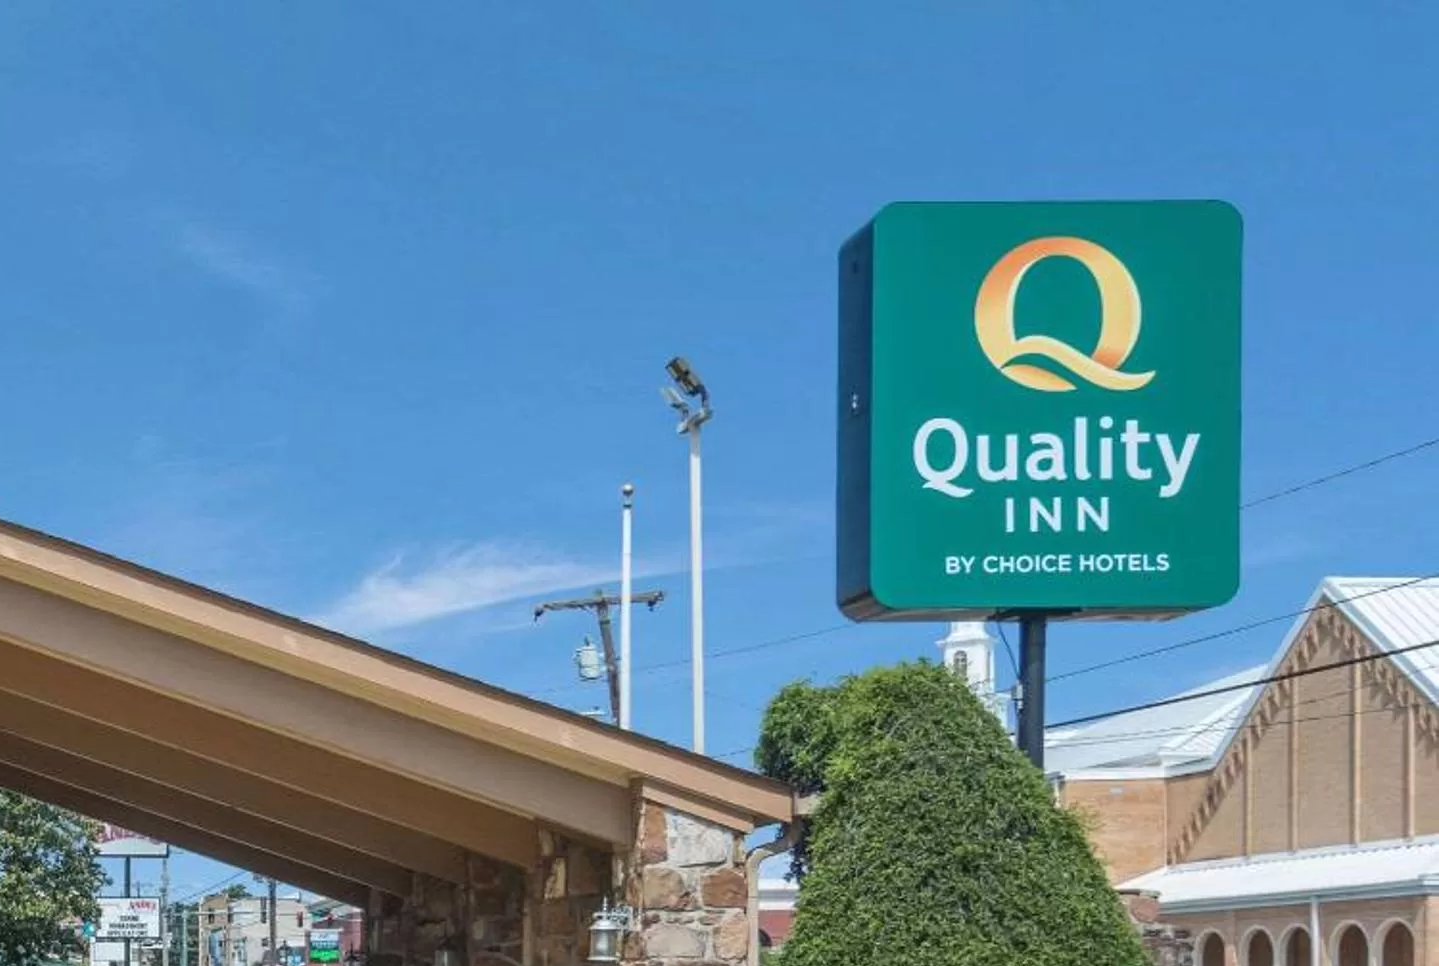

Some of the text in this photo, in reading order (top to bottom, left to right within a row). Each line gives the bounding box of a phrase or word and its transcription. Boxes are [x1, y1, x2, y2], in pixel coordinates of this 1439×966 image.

[913, 416, 1201, 498] Quality
[1005, 496, 1110, 533] INN
[945, 553, 1170, 574] BY CHOICE HOTELS
